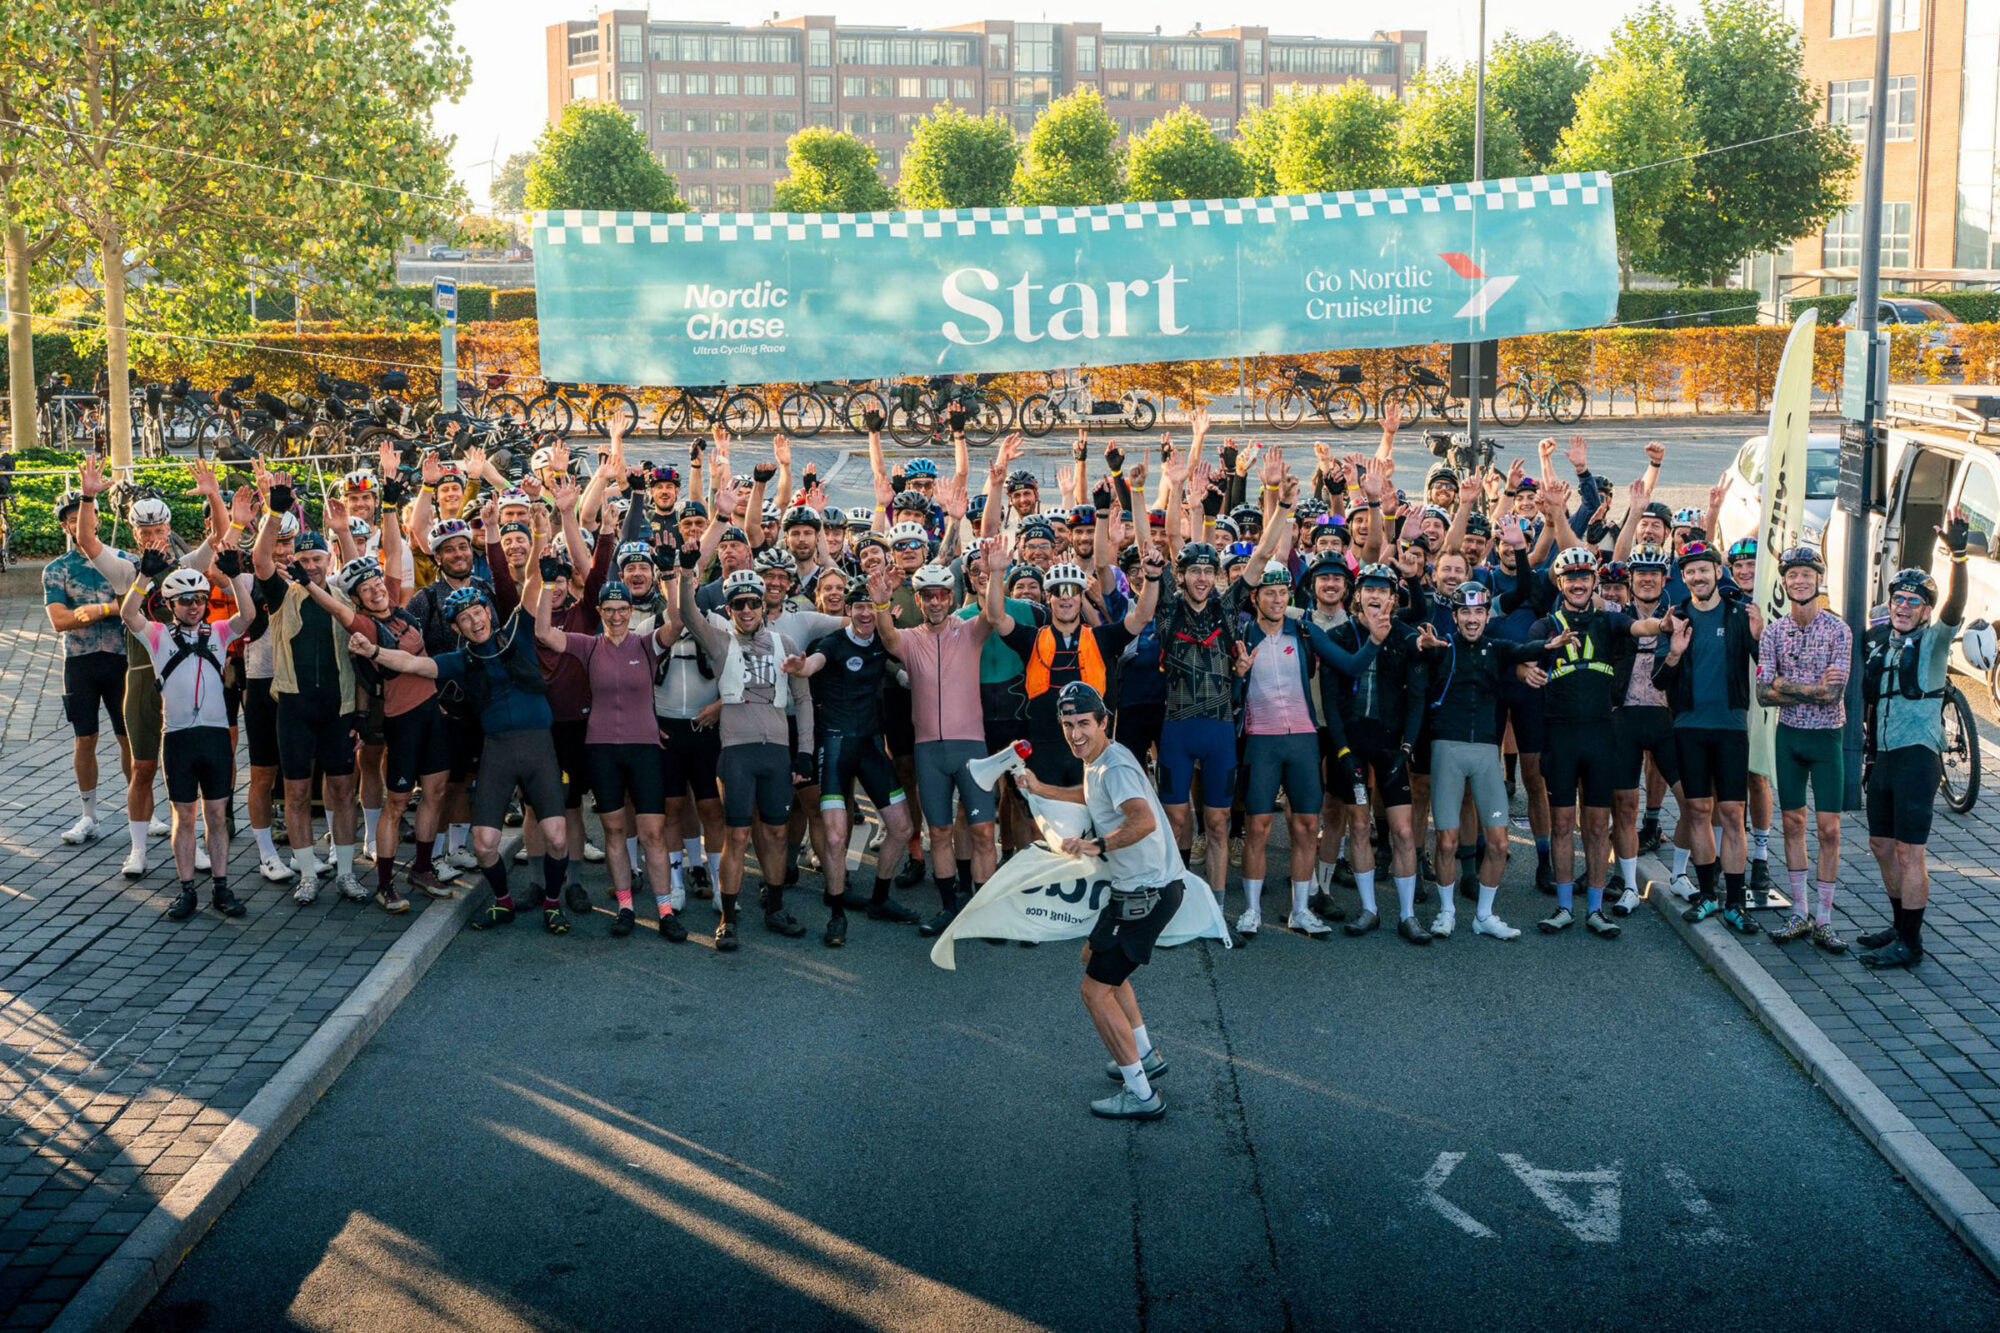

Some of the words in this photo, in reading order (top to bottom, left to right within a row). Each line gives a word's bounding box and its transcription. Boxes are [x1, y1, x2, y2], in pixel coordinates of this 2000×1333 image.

[1306, 270, 1342, 293] Go
[1349, 265, 1433, 290] Nordic
[684, 280, 789, 309] Nordic
[942, 264, 1190, 345] Start
[1306, 293, 1433, 320] Cruiseline
[693, 345, 718, 355] Ultra
[720, 344, 758, 356] Cycling
[760, 344, 786, 353] Race
